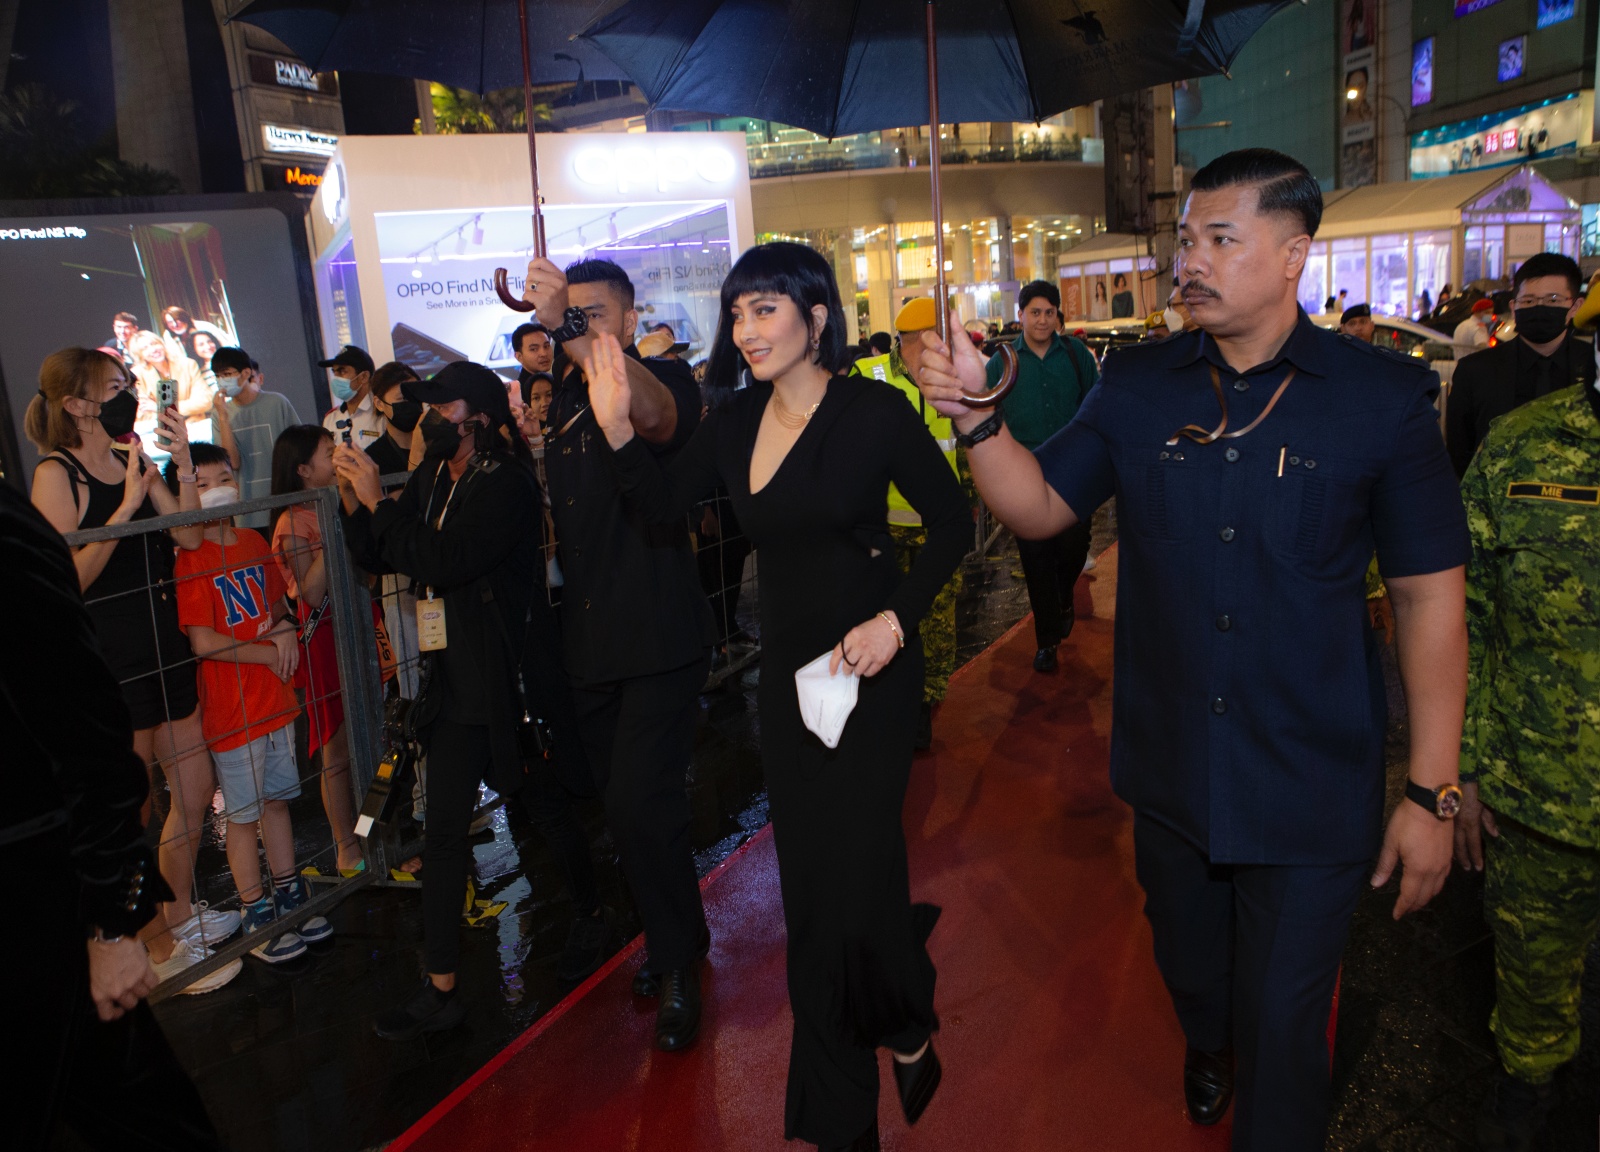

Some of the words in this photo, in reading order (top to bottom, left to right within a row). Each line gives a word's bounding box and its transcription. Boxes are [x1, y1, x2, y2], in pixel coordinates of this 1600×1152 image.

[397, 281, 443, 298] OPPO
[446, 280, 479, 294] Find
[481, 278, 498, 292] N
[426, 301, 443, 310] See
[445, 299, 468, 309] More
[469, 298, 477, 307] in
[1541, 486, 1563, 498] MIE
[213, 564, 270, 627] NY
